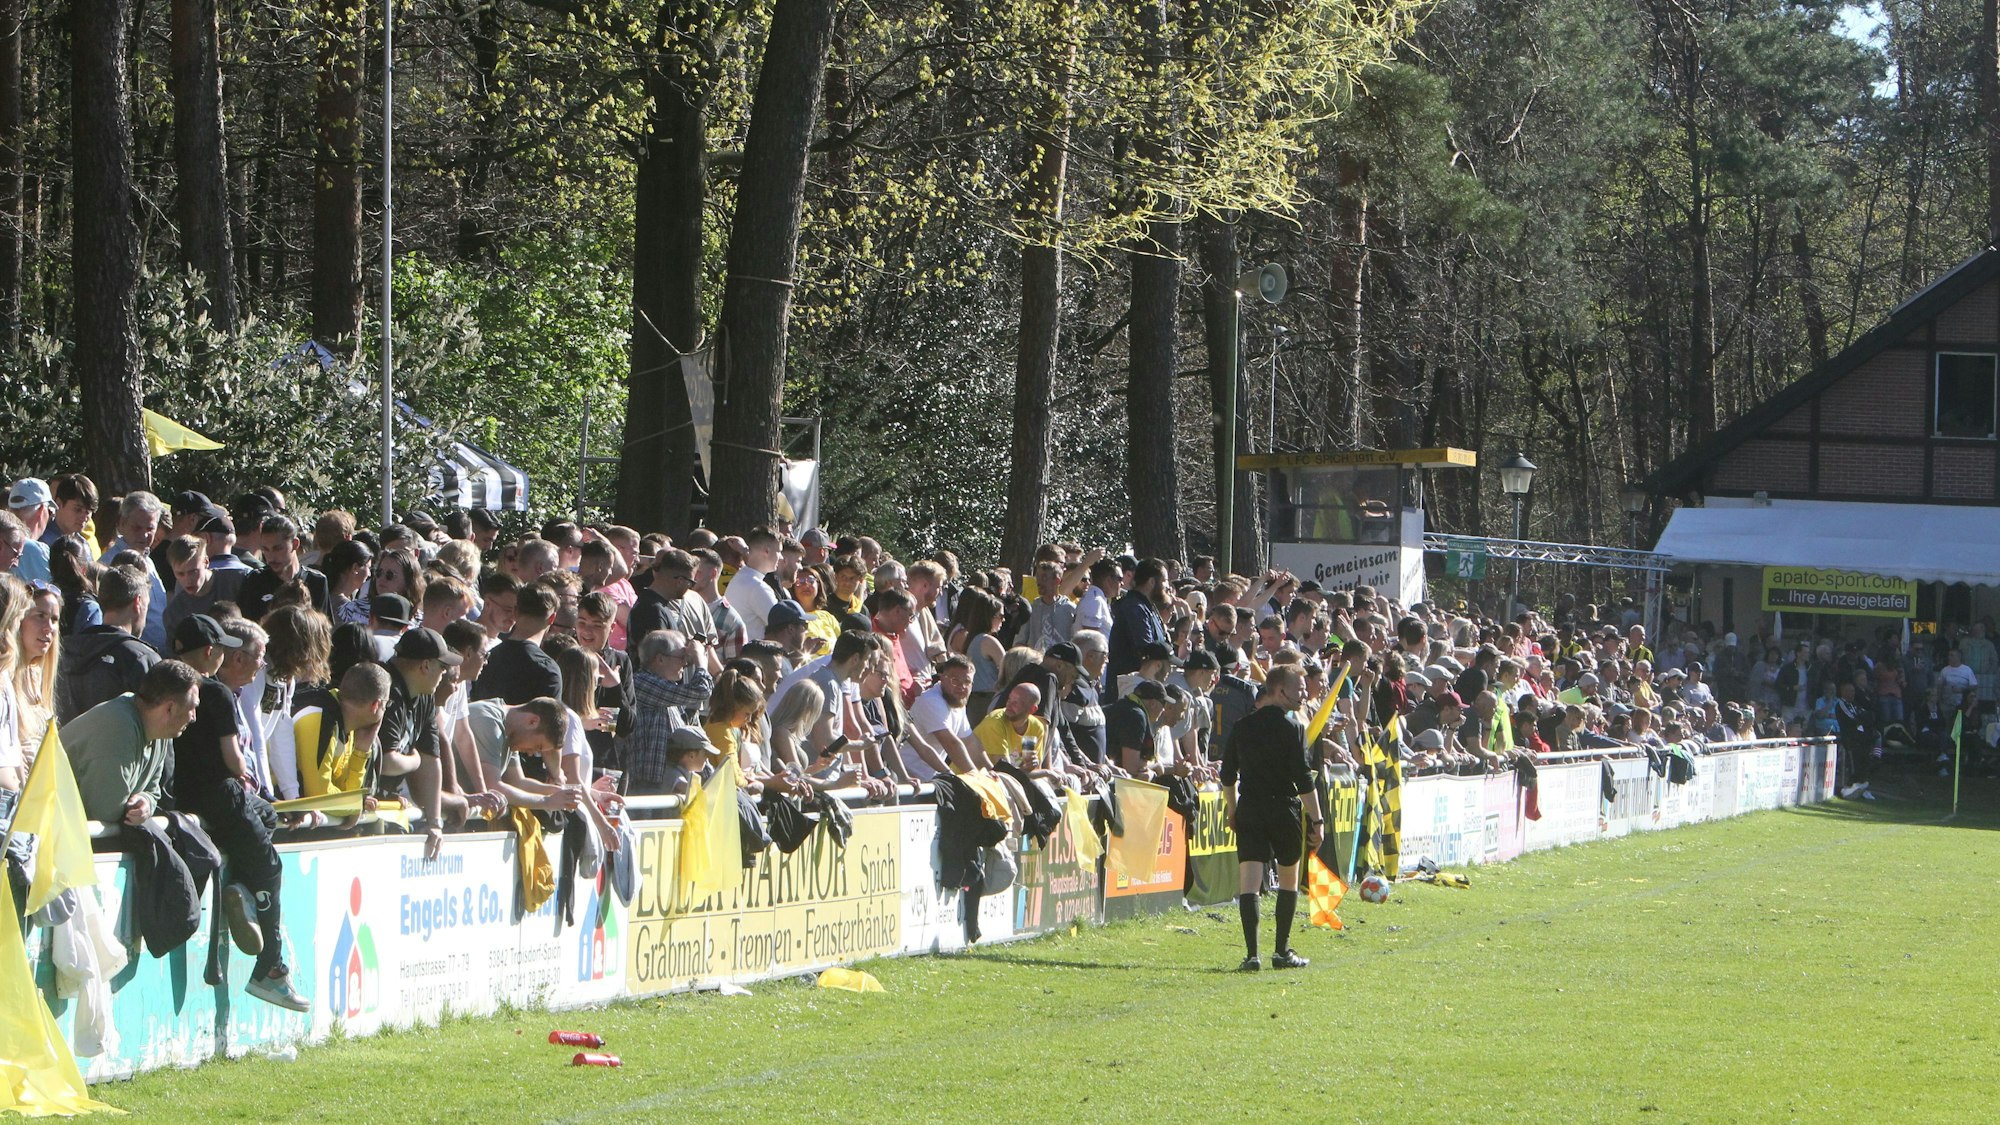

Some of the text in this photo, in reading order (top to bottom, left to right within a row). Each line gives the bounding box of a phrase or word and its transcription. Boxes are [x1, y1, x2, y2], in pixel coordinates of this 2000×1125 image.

[1315, 453, 1349, 464] SPICH
[1355, 452, 1373, 462] 1911
[1315, 551, 1398, 582] Gemeinsam
[1368, 571, 1390, 586] wir
[1789, 590, 1816, 604] Ihre
[1819, 592, 1907, 610] Anzeigetafel
[400, 853, 463, 879] Bauzentrum
[861, 842, 896, 905] Spich
[400, 888, 458, 942] Engels
[462, 886, 474, 926] &
[478, 883, 503, 925] Co.
[635, 902, 896, 983] Grabmale Treppen Fensterbänke
[400, 958, 446, 979] Hauptstrasse
